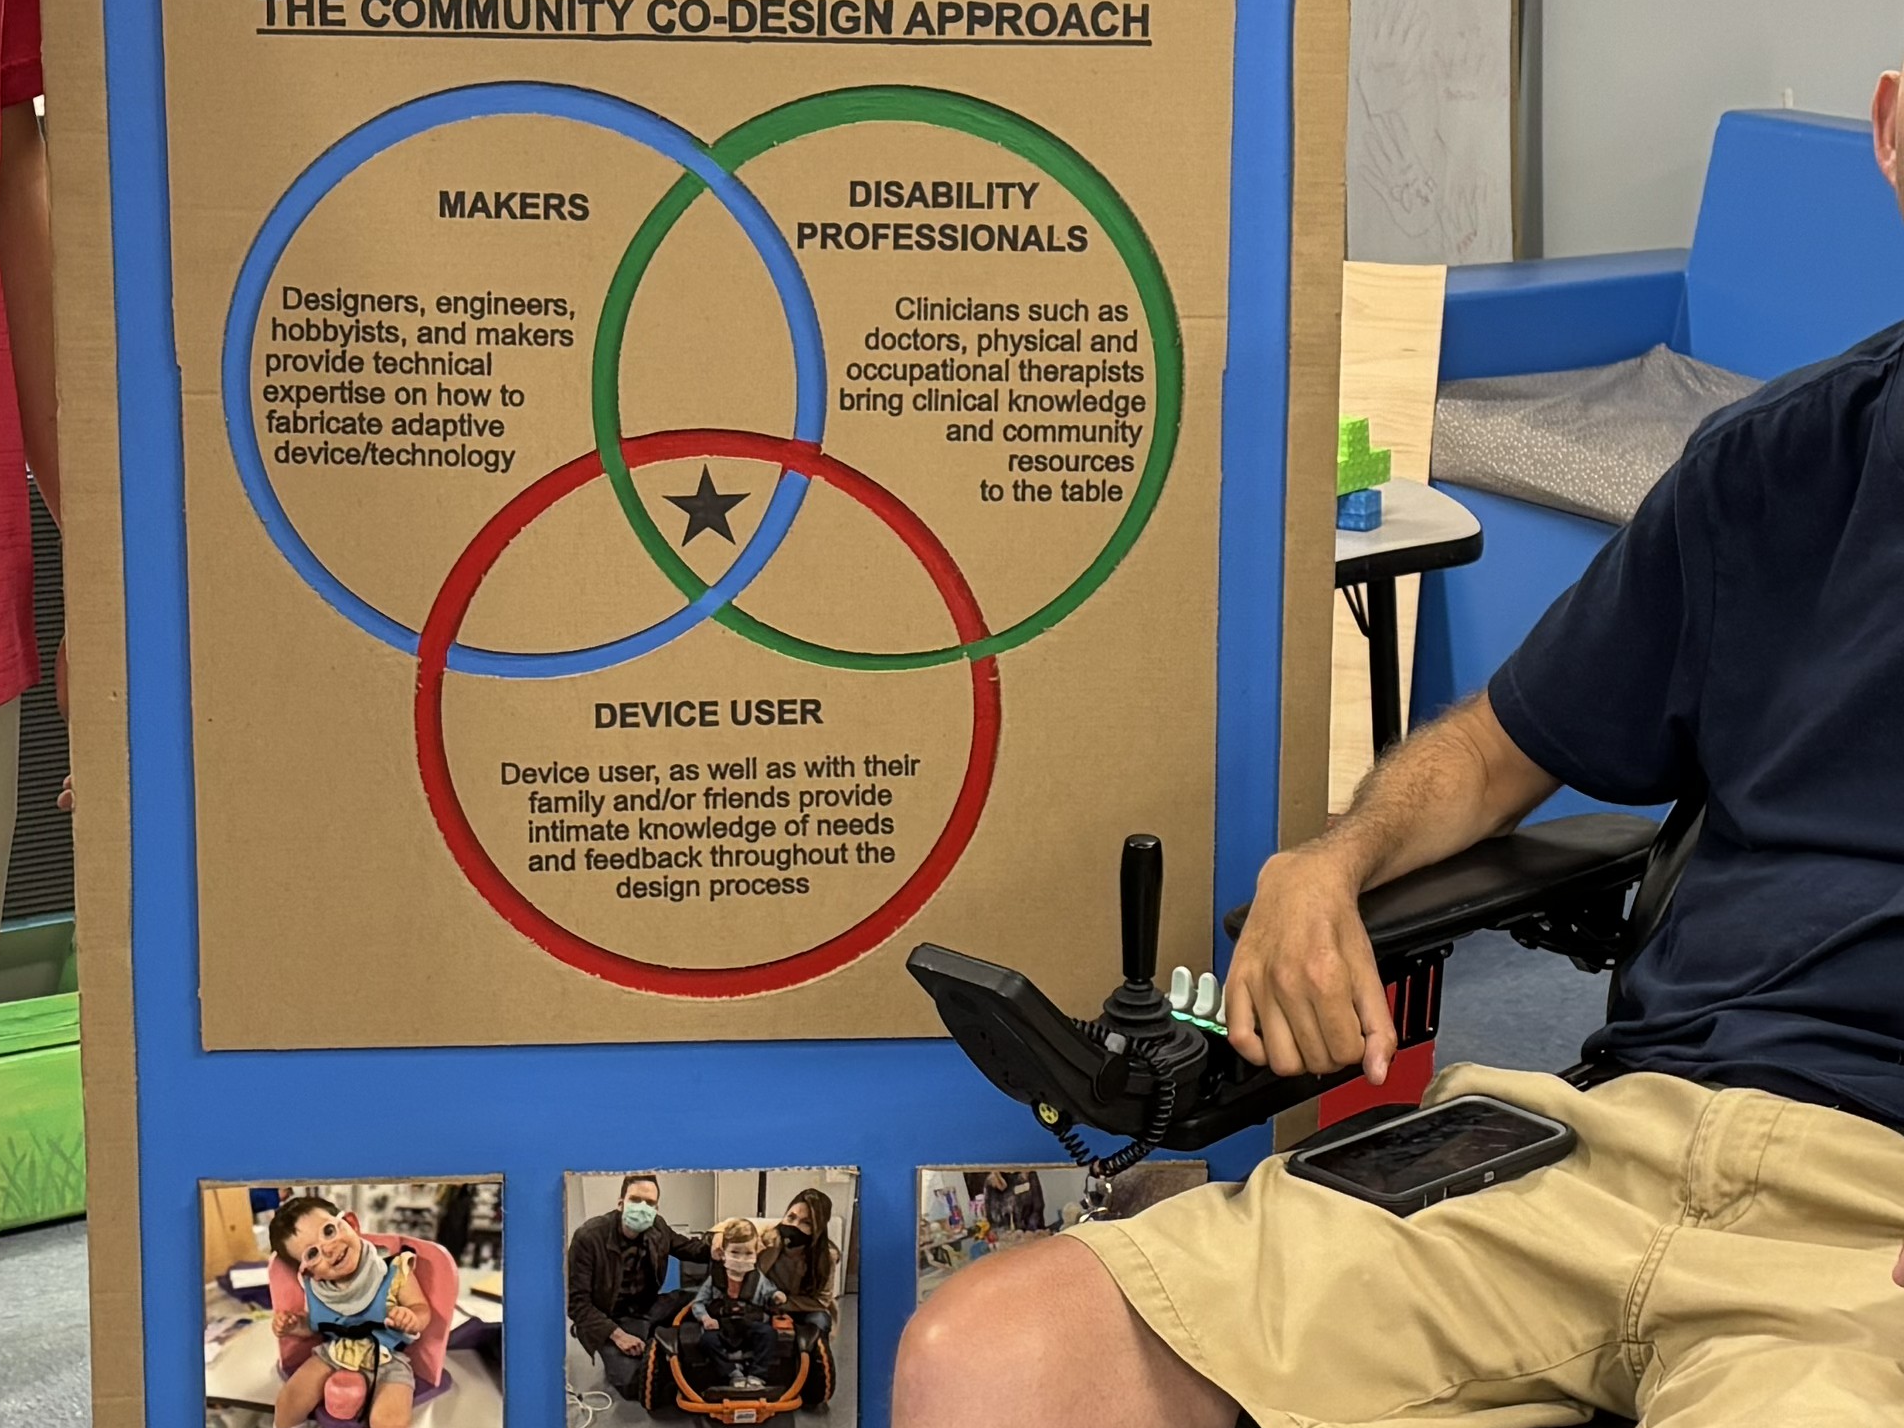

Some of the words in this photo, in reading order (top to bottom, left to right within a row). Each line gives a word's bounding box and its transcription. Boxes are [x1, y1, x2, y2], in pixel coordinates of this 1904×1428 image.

[902, 0, 1150, 38] APPROACH
[439, 190, 590, 222] MAKERS
[849, 180, 1040, 210] DISABILITY
[796, 221, 1089, 253] PROFESSIONALS
[282, 285, 426, 318] Designers,
[435, 290, 575, 321] engineers,
[895, 296, 1021, 322] Clinicians
[1028, 298, 1089, 323] such
[1097, 304, 1129, 323] as
[271, 316, 407, 349] hobbyists,
[416, 320, 467, 345] and
[476, 321, 574, 348] makers
[864, 326, 968, 355] doctors,
[977, 327, 1082, 357] physical
[1090, 328, 1138, 354] and
[265, 348, 365, 378] provide
[372, 350, 492, 377] technical
[846, 357, 1010, 387] occupational
[1018, 358, 1145, 389] therapists
[262, 379, 386, 407] expertise
[394, 386, 427, 406] on
[437, 381, 492, 407] how
[499, 384, 525, 408] to
[839, 386, 904, 417] bring
[912, 387, 999, 413] clinical
[1008, 388, 1147, 419] knowledge
[265, 408, 384, 436] fabricate
[391, 411, 505, 443] adaptive
[945, 418, 994, 442] and
[1002, 418, 1144, 449] community
[273, 439, 516, 474] device/technology
[1008, 453, 1135, 473] resources
[979, 479, 1004, 502] to
[1011, 478, 1053, 503] the
[1060, 478, 1124, 503] table
[594, 700, 720, 729] DEVICE
[730, 698, 824, 726] USER
[501, 760, 590, 786] Device
[598, 764, 660, 786] user,
[669, 763, 700, 782] as
[706, 756, 757, 781] well
[765, 761, 797, 780] as
[803, 754, 856, 779] with
[863, 753, 921, 778] their
[527, 789, 606, 818] family
[613, 787, 697, 813] and/or
[702, 785, 791, 810] friends
[799, 782, 893, 814] provide
[528, 818, 630, 844] intimate
[638, 814, 777, 844] knowledge
[784, 813, 811, 837] of
[816, 811, 895, 837] needs
[528, 847, 576, 873] and
[583, 845, 703, 871] feedback
[709, 842, 849, 872] throughout
[855, 840, 896, 864] the
[615, 874, 701, 903] design
[709, 876, 810, 902] process
